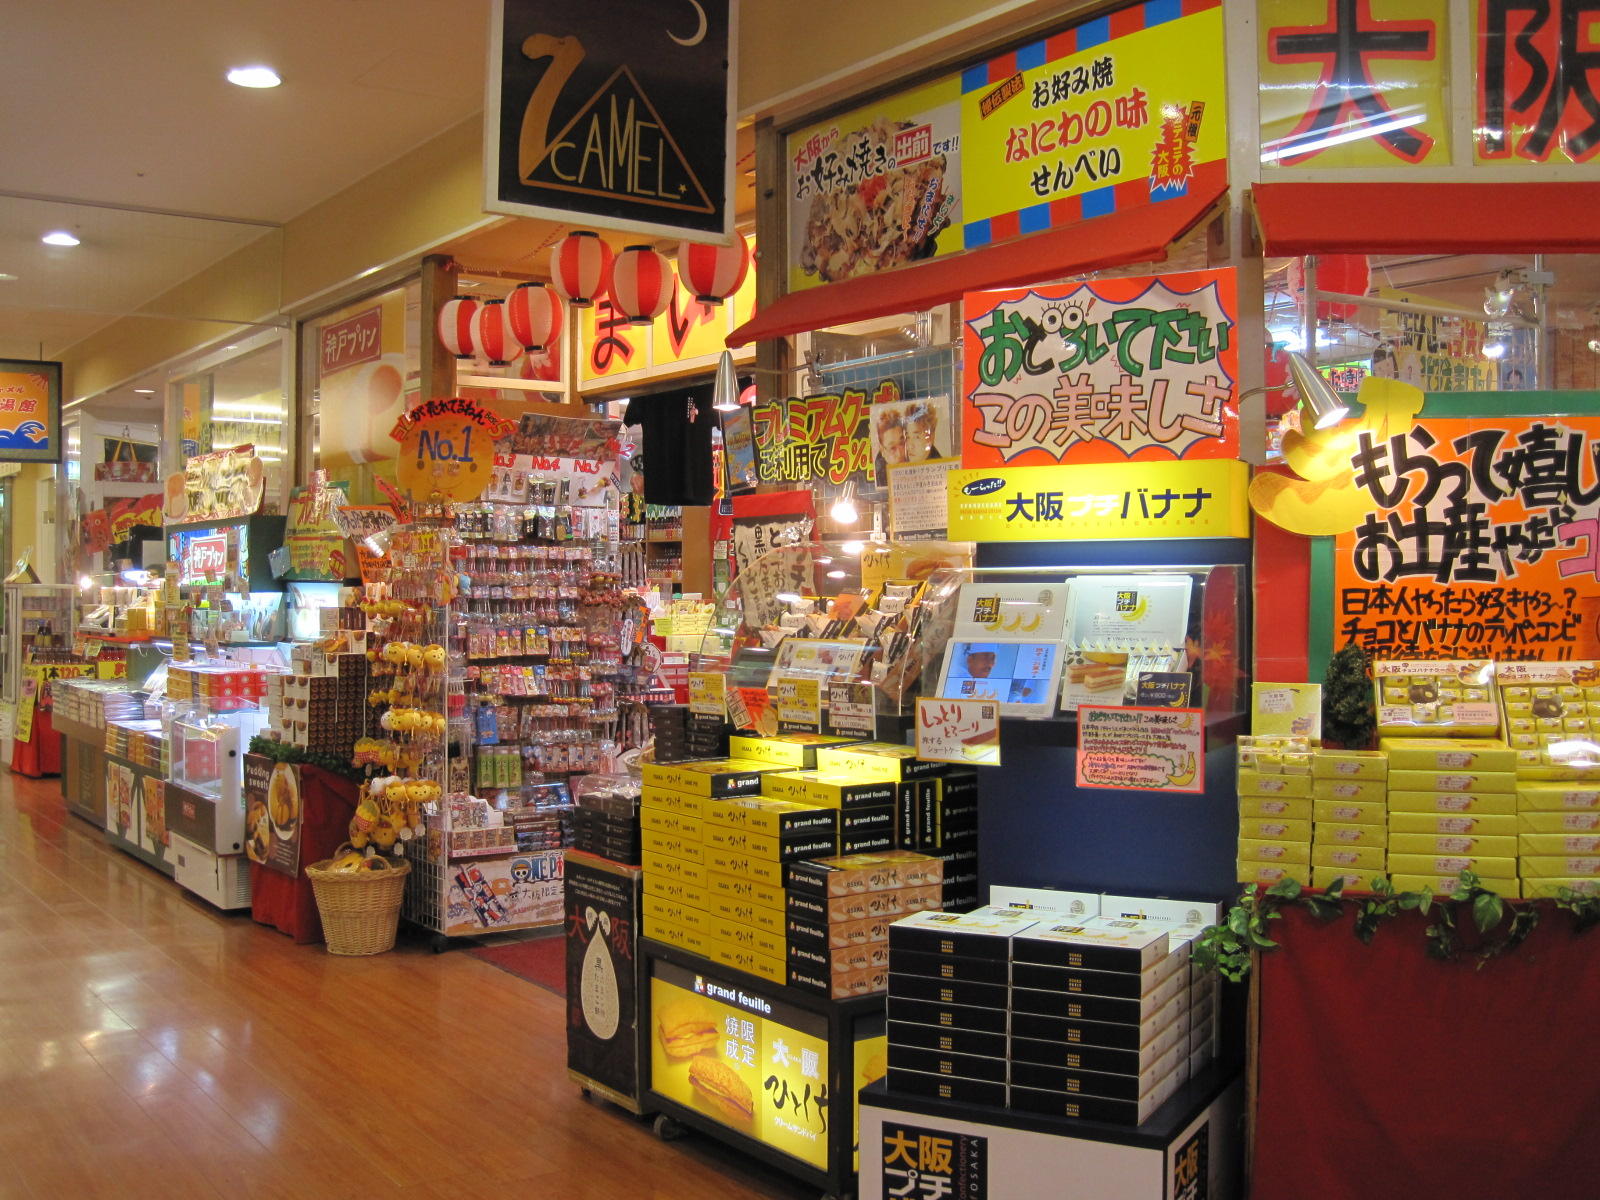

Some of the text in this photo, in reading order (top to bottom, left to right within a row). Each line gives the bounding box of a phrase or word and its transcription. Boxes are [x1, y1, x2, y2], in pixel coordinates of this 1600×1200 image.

[1032, 56, 1114, 109] お好み焼
[1005, 87, 1149, 163] なにわの味
[551, 94, 681, 199] CAMEL
[1030, 148, 1121, 196] せんべい
[325, 324, 377, 361] 神戸プリン
[972, 373, 1232, 448] この美味しさ
[418, 426, 474, 462] No.1
[1350, 422, 1600, 511] もらって嬉し
[1005, 487, 1212, 522] 大阪プチバナナ
[921, 703, 962, 728] しっとり
[737, 777, 759, 788] grand
[855, 790, 890, 800] grand feuille
[794, 817, 831, 828] grand feuille
[854, 817, 870, 825] grand
[794, 842, 831, 852] grand feuille
[854, 838, 889, 849] grand feuille
[707, 982, 772, 1014] grand feuille
[884, 1130, 954, 1175] 大阪
[970, 1139, 979, 1192] OSAKA
